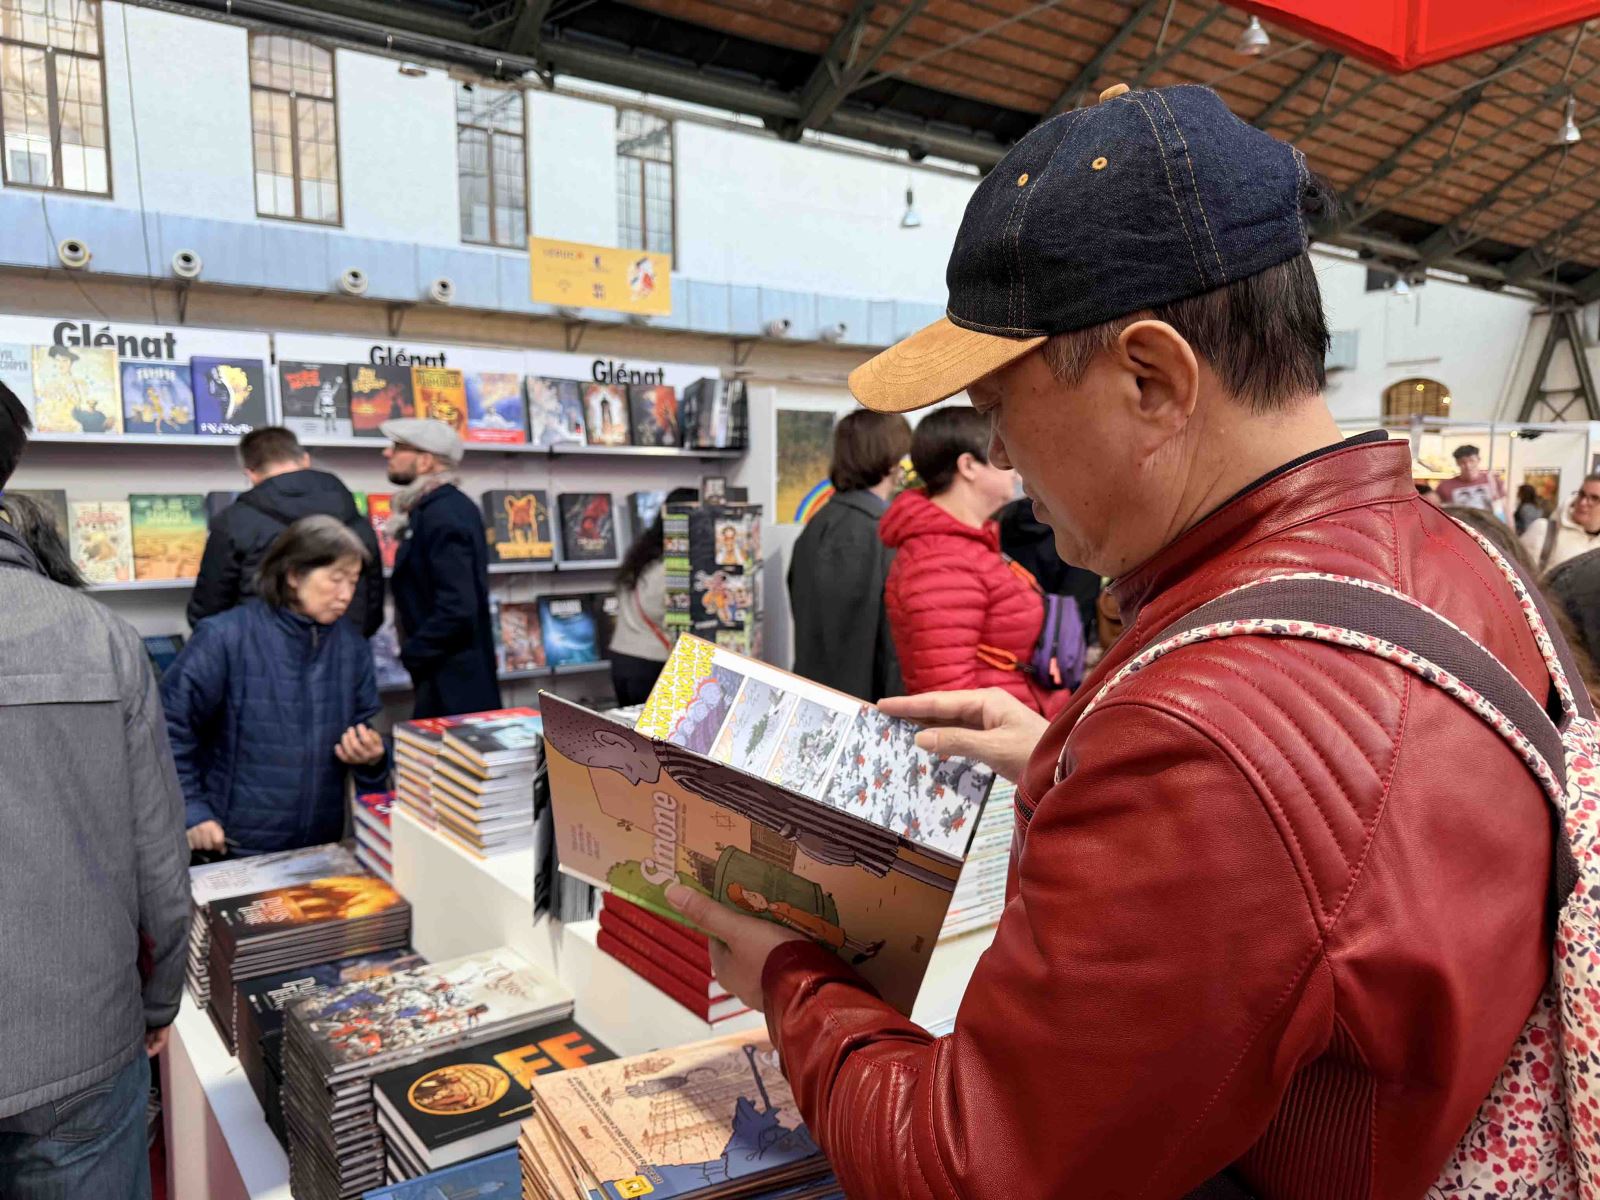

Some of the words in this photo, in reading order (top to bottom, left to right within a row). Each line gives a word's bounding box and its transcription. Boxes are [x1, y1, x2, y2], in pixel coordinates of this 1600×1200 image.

[54, 322, 176, 359] Glénat
[370, 345, 446, 367] Glénat
[593, 360, 664, 385] Glénat
[640, 790, 681, 886] Simone
